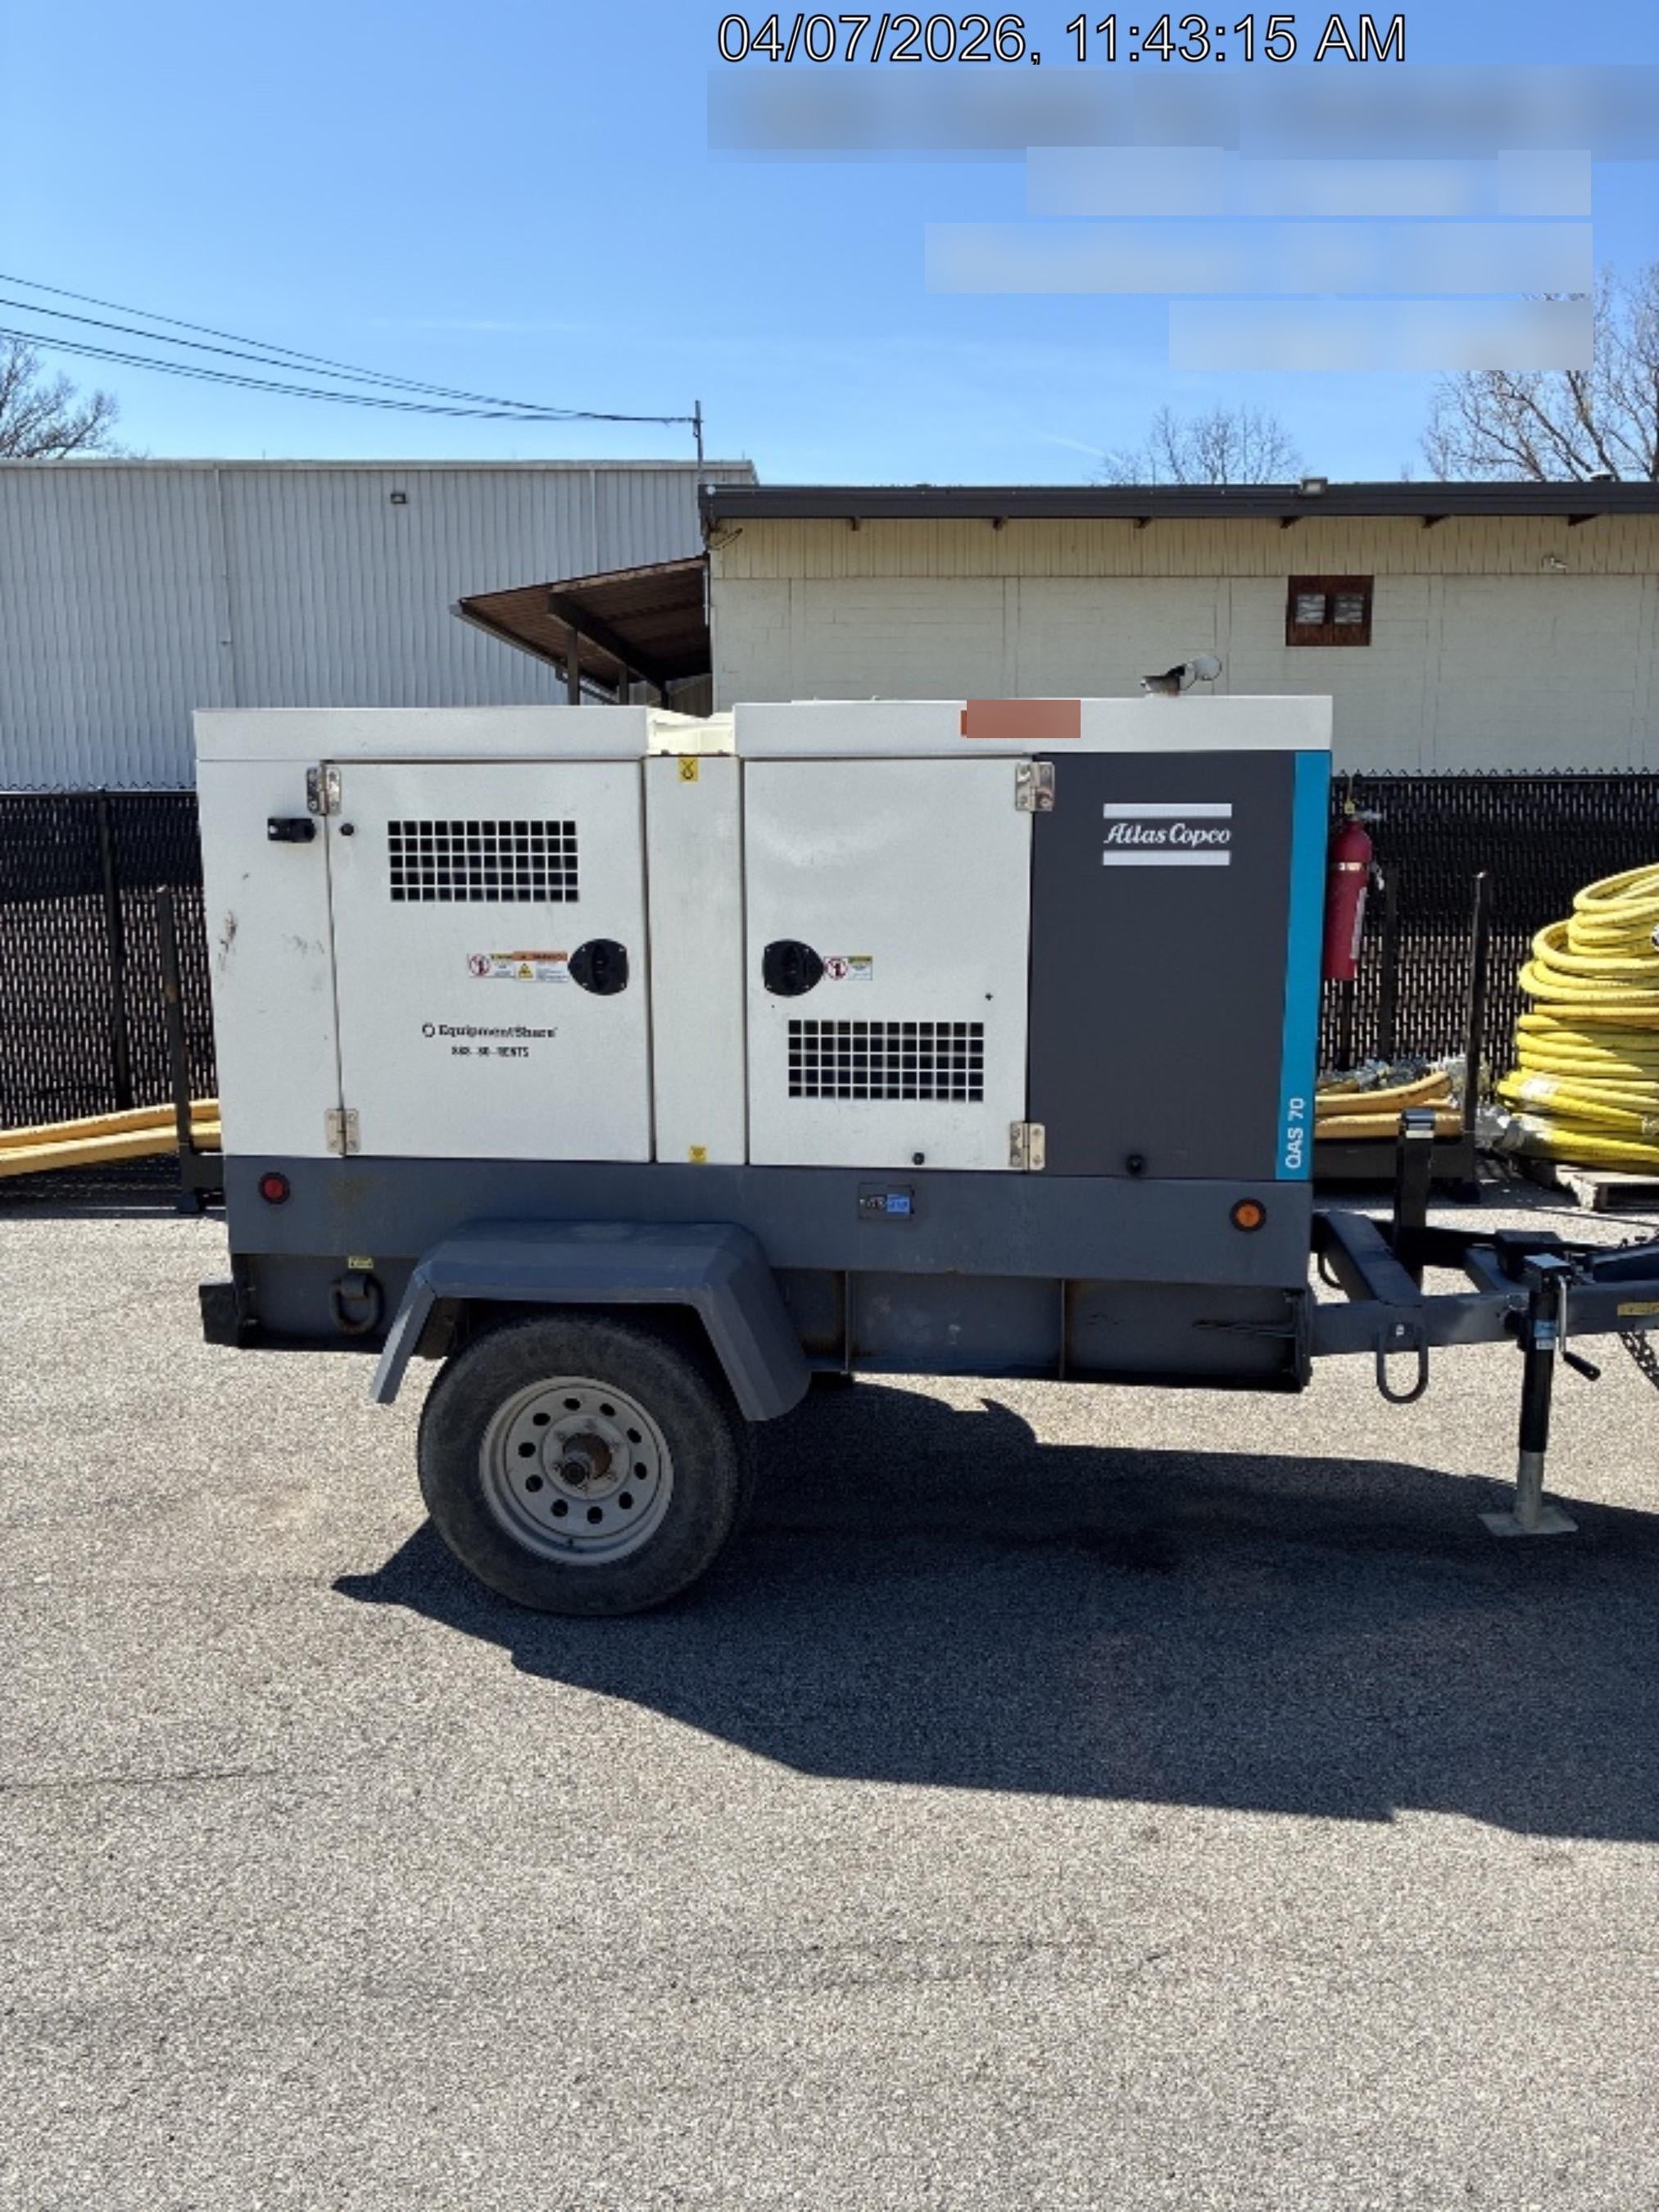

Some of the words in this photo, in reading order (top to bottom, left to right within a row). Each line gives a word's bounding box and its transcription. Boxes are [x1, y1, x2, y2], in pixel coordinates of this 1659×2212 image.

[1103, 822, 1167, 845] Atlas
[1169, 822, 1231, 849] Copco
[438, 1023, 557, 1038] EquipmentShare
[1287, 1097, 1305, 1122] 70
[1285, 1127, 1304, 1168] QAS
